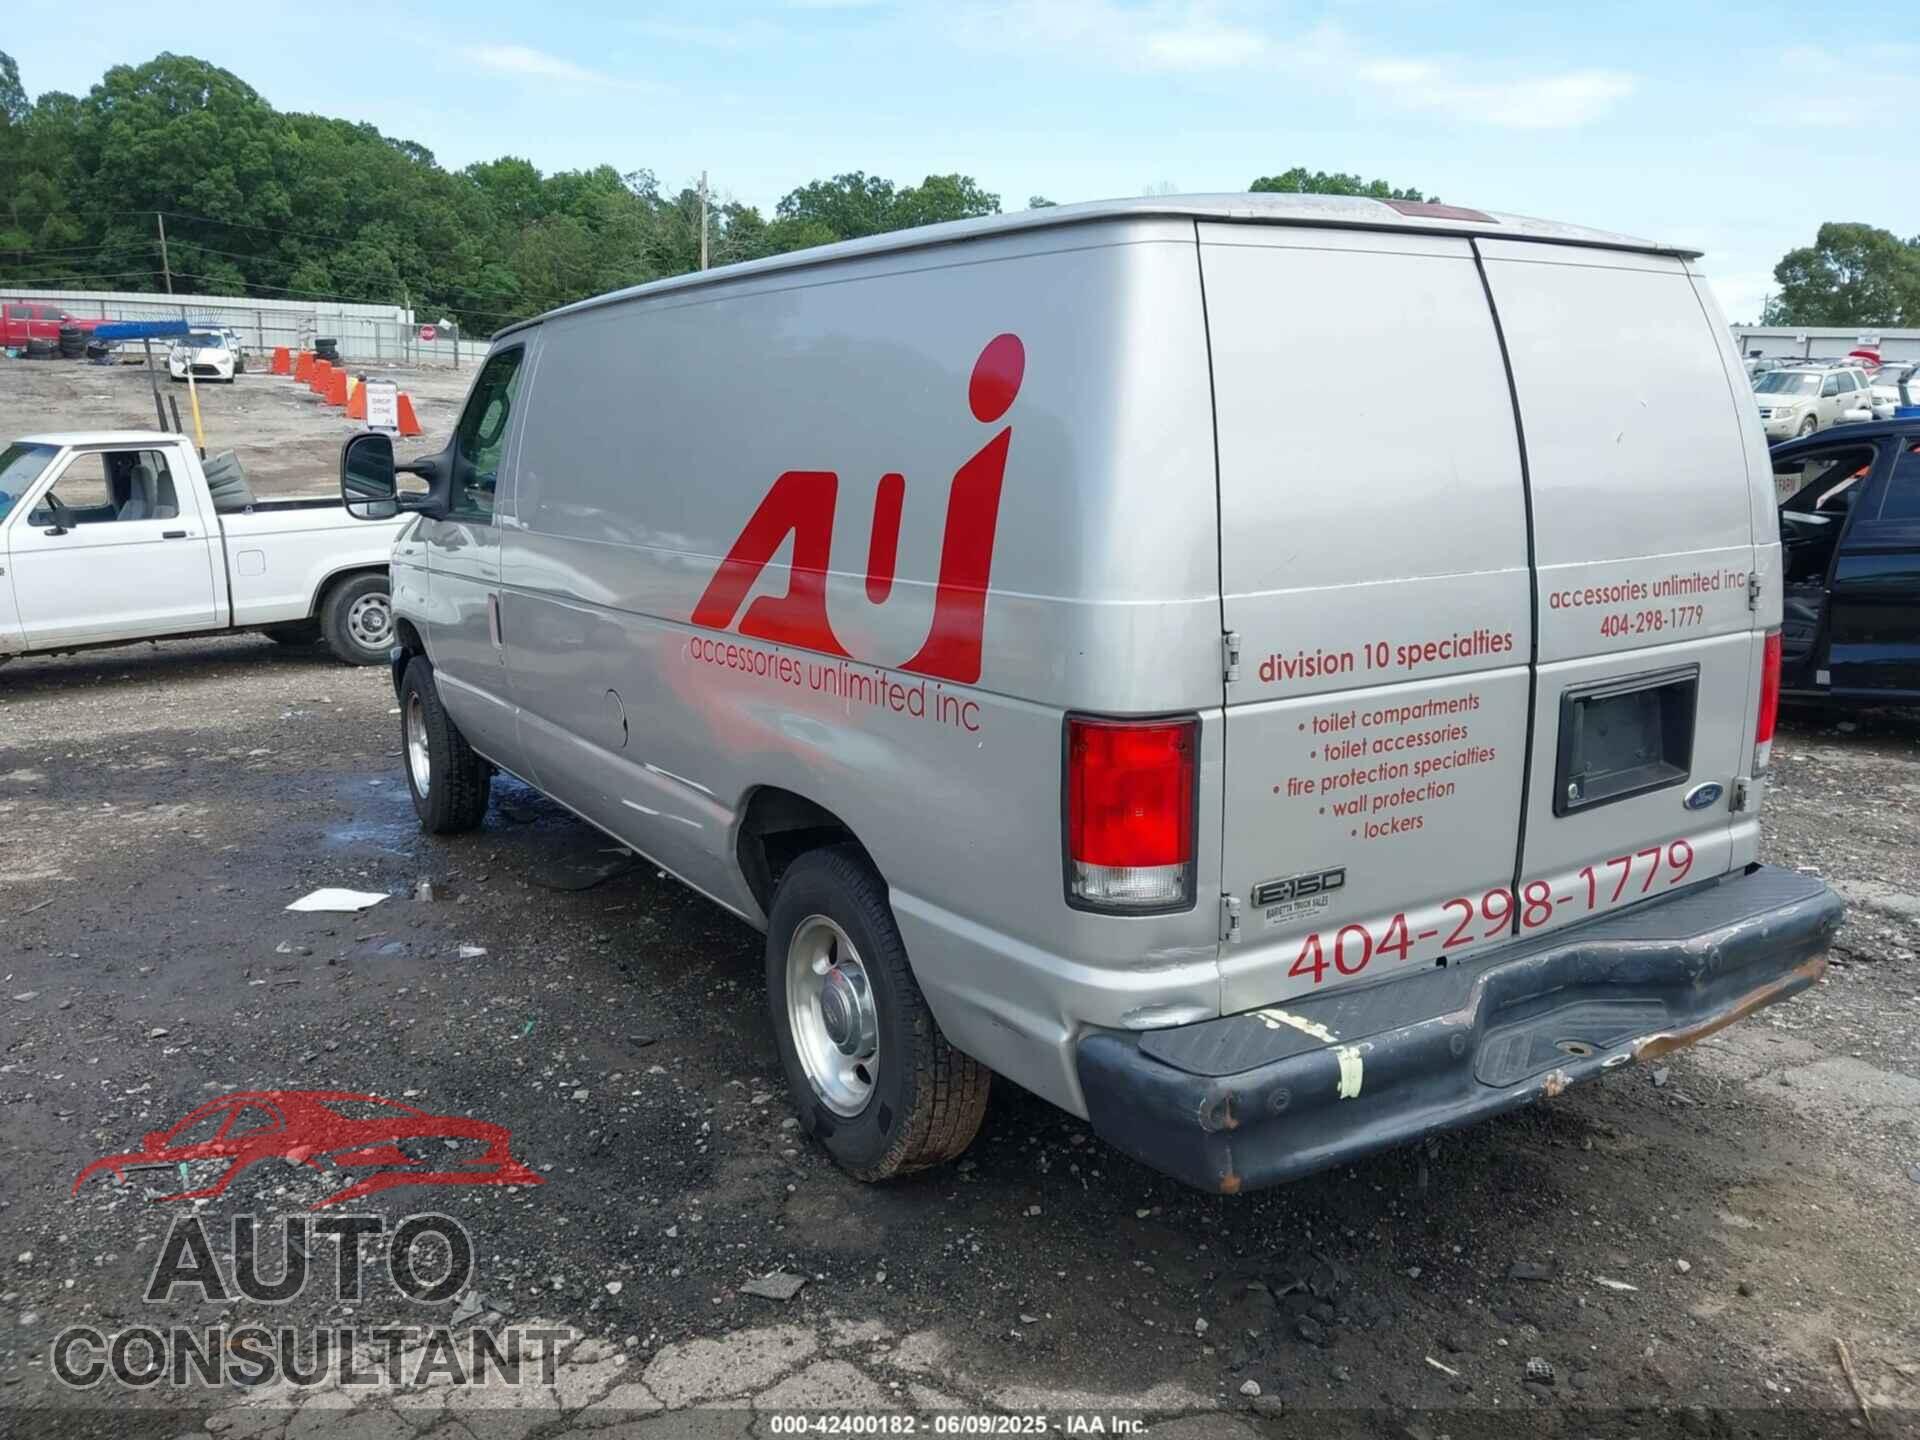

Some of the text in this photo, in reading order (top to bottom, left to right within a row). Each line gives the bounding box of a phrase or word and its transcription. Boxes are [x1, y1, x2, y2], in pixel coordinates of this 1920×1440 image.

[1550, 569, 1745, 609] accessories unlimited inc
[1600, 604, 1703, 637] 404-298-1779
[1258, 628, 1513, 683] division 10 specialties
[690, 635, 981, 732] accessories unlimited inc
[1312, 693, 1480, 735] toilet compartments
[1324, 724, 1468, 762] toilet accessories
[1286, 746, 1496, 797] fire protection specialties
[1332, 781, 1456, 817] wall protection
[1363, 814, 1424, 839] lockers
[1287, 839, 1695, 984] 404-298-1779
[1294, 901, 1311, 910] TRUCK
[1312, 895, 1328, 907] SALES
